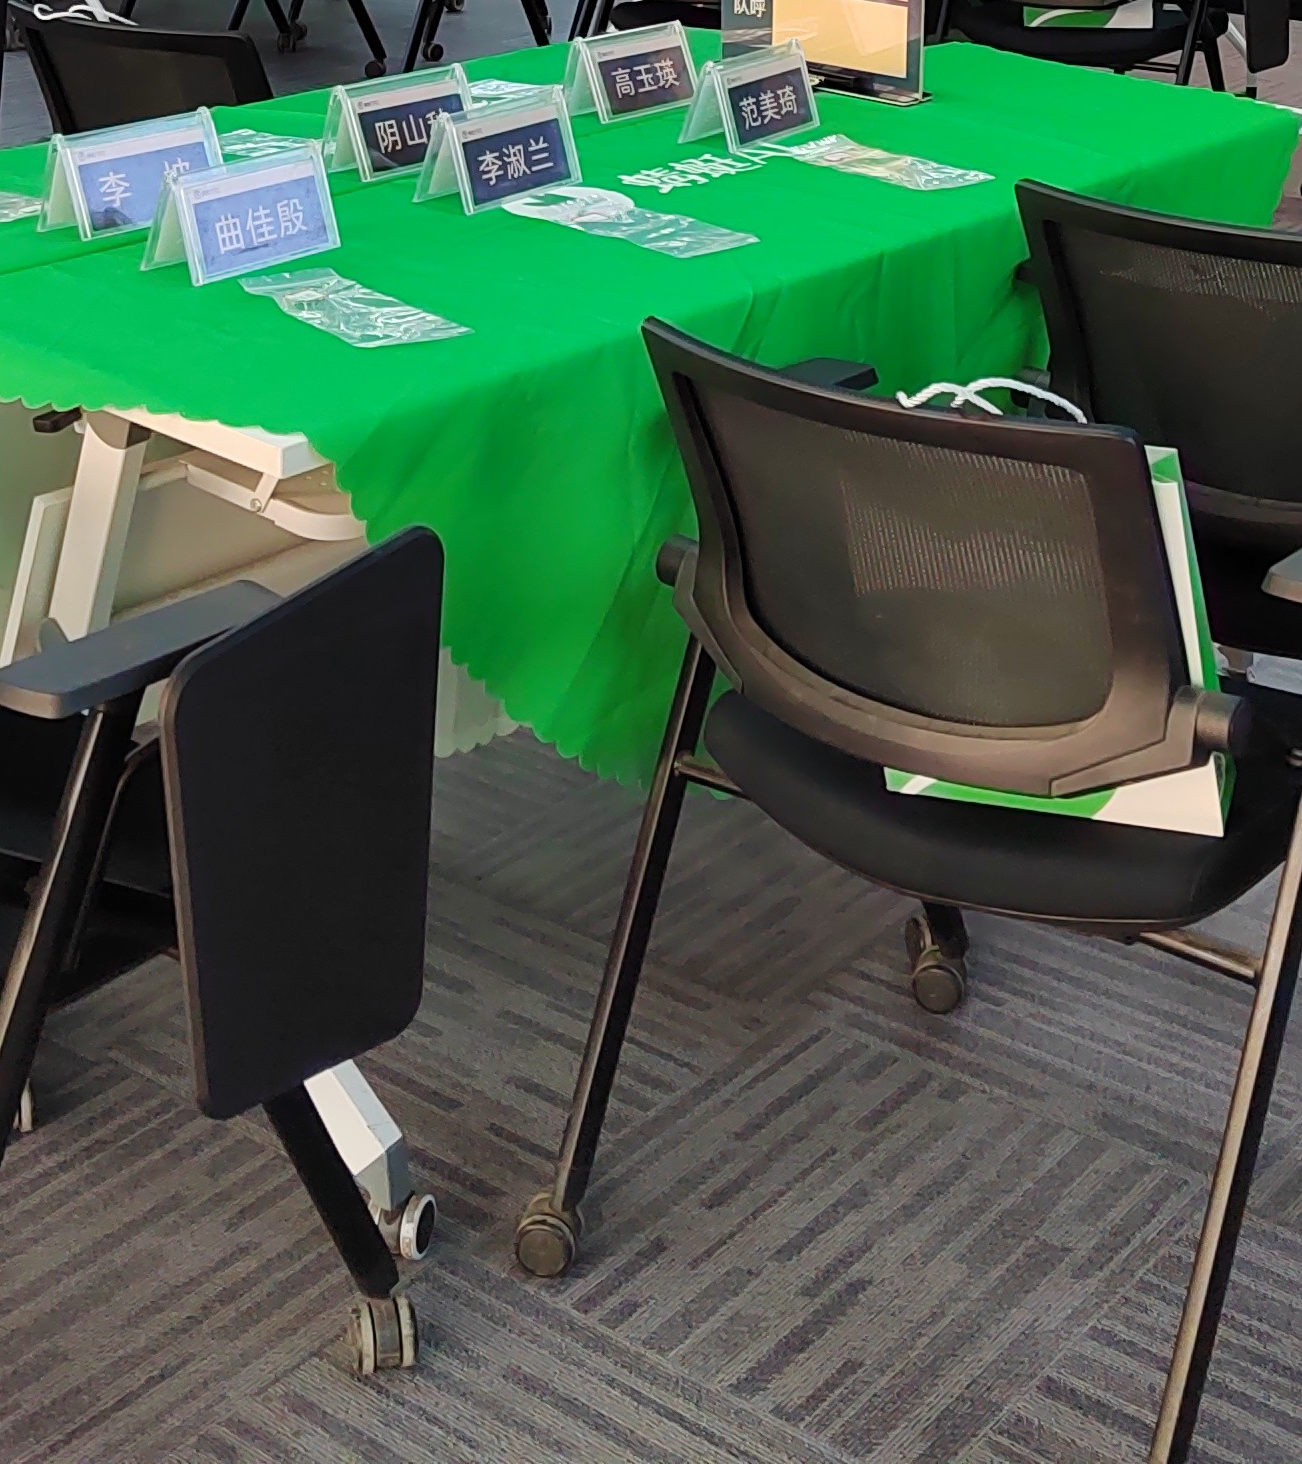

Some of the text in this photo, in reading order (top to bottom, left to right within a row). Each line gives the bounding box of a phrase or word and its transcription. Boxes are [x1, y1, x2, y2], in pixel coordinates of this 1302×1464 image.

[476, 135, 555, 187] 李淑兰
[214, 198, 308, 255] 曲佳殷
